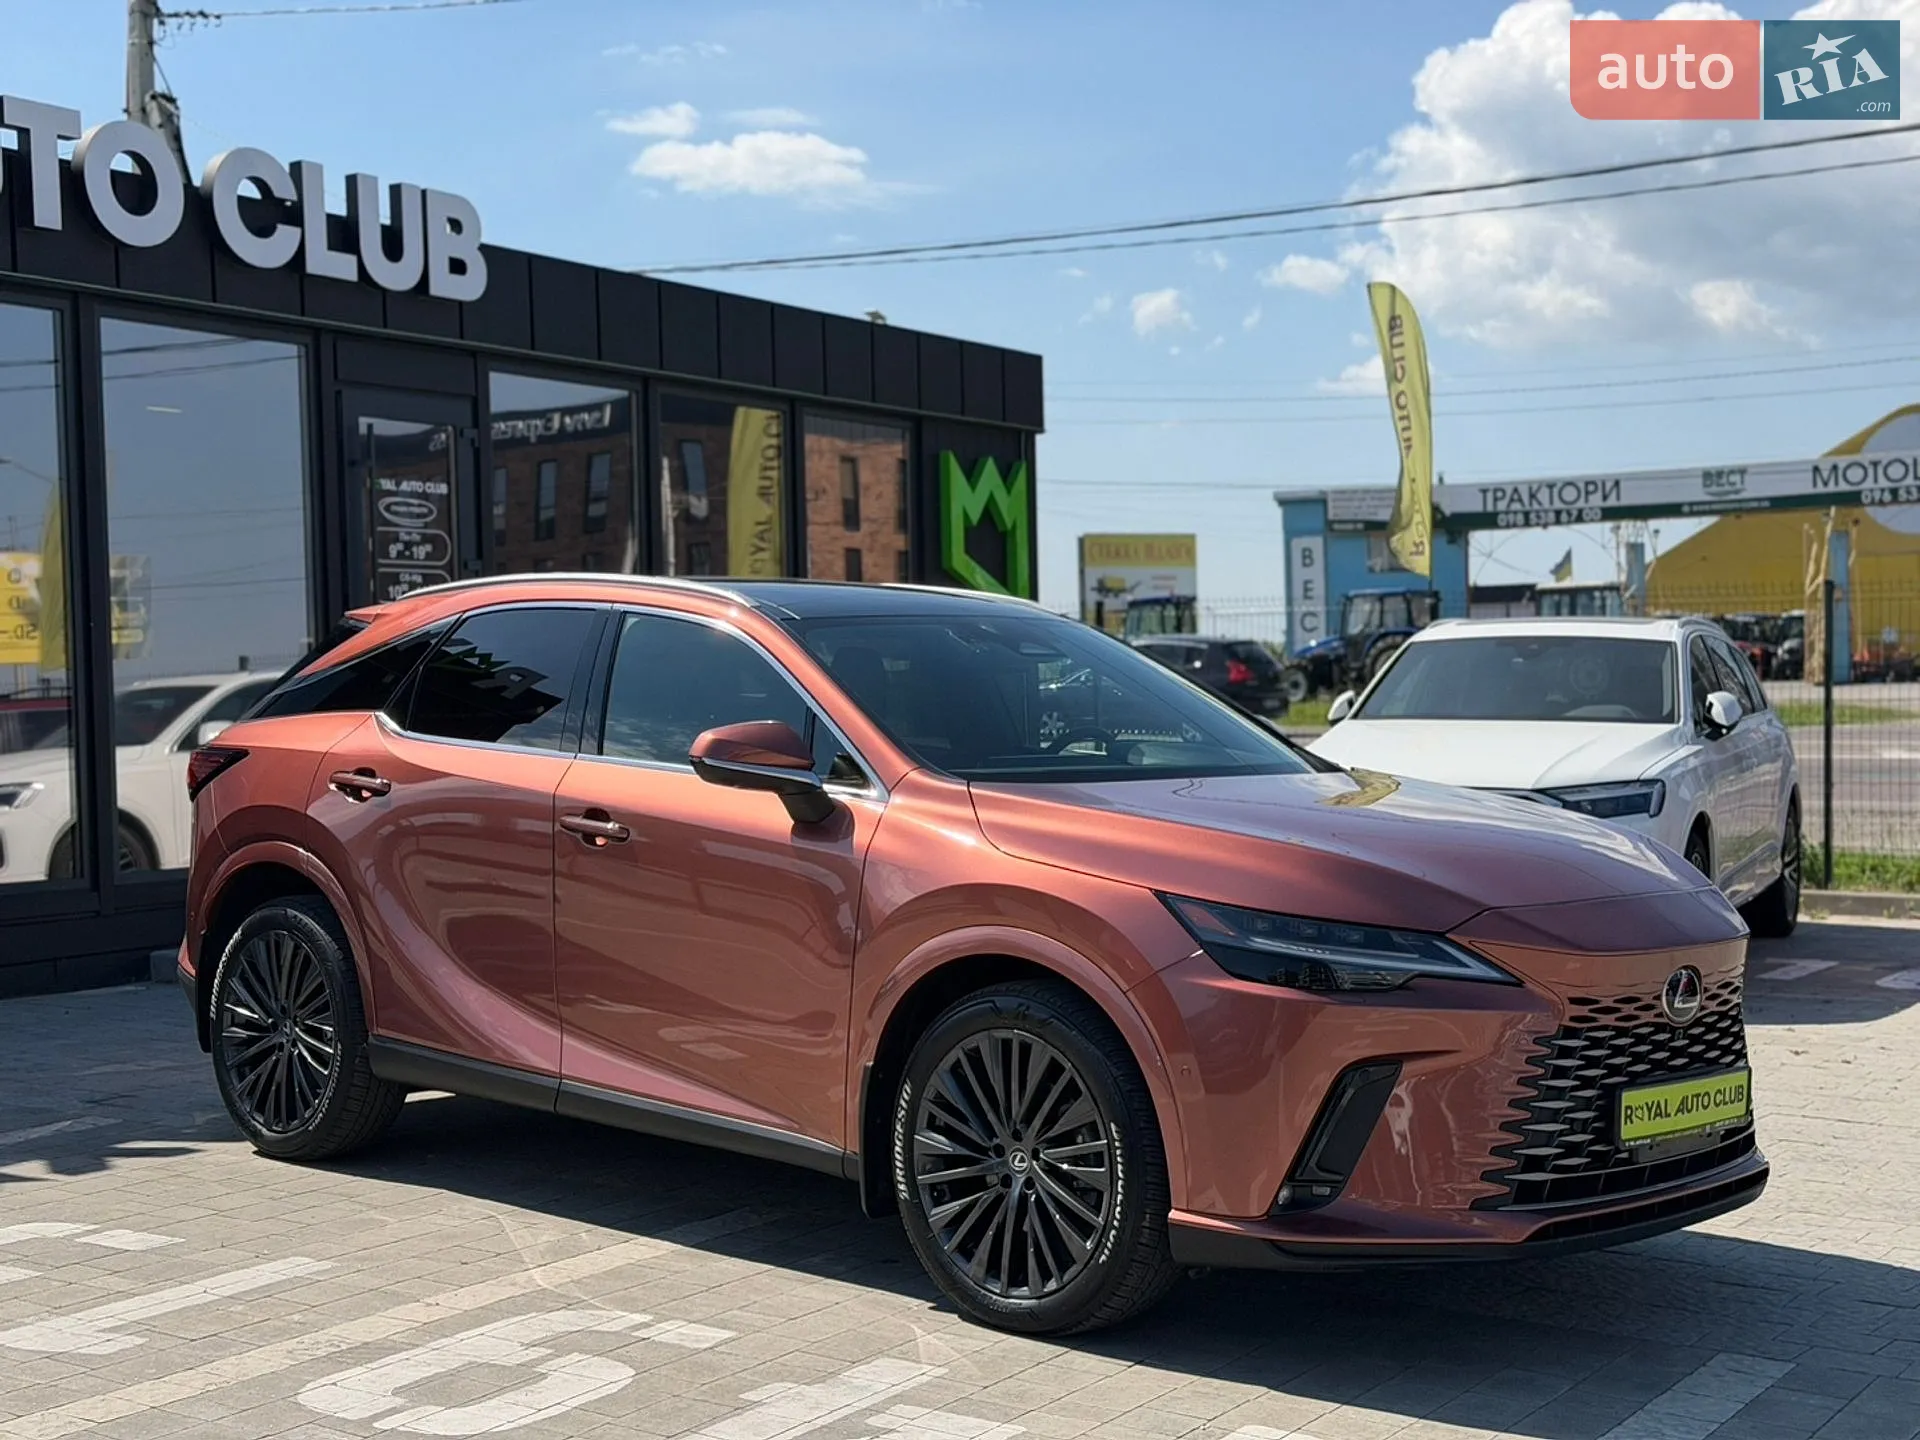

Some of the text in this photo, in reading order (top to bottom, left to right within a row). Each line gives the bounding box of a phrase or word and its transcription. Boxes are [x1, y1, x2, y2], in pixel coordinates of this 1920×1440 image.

[0, 95, 488, 301] TO CLUB
[399, 480, 424, 493] AUTO
[425, 481, 448, 495] CLUB
[1478, 479, 1621, 512] ТРАКТОРИ
[1674, 1091, 1711, 1117] AUTO
[1714, 1085, 1744, 1107] CLUB
